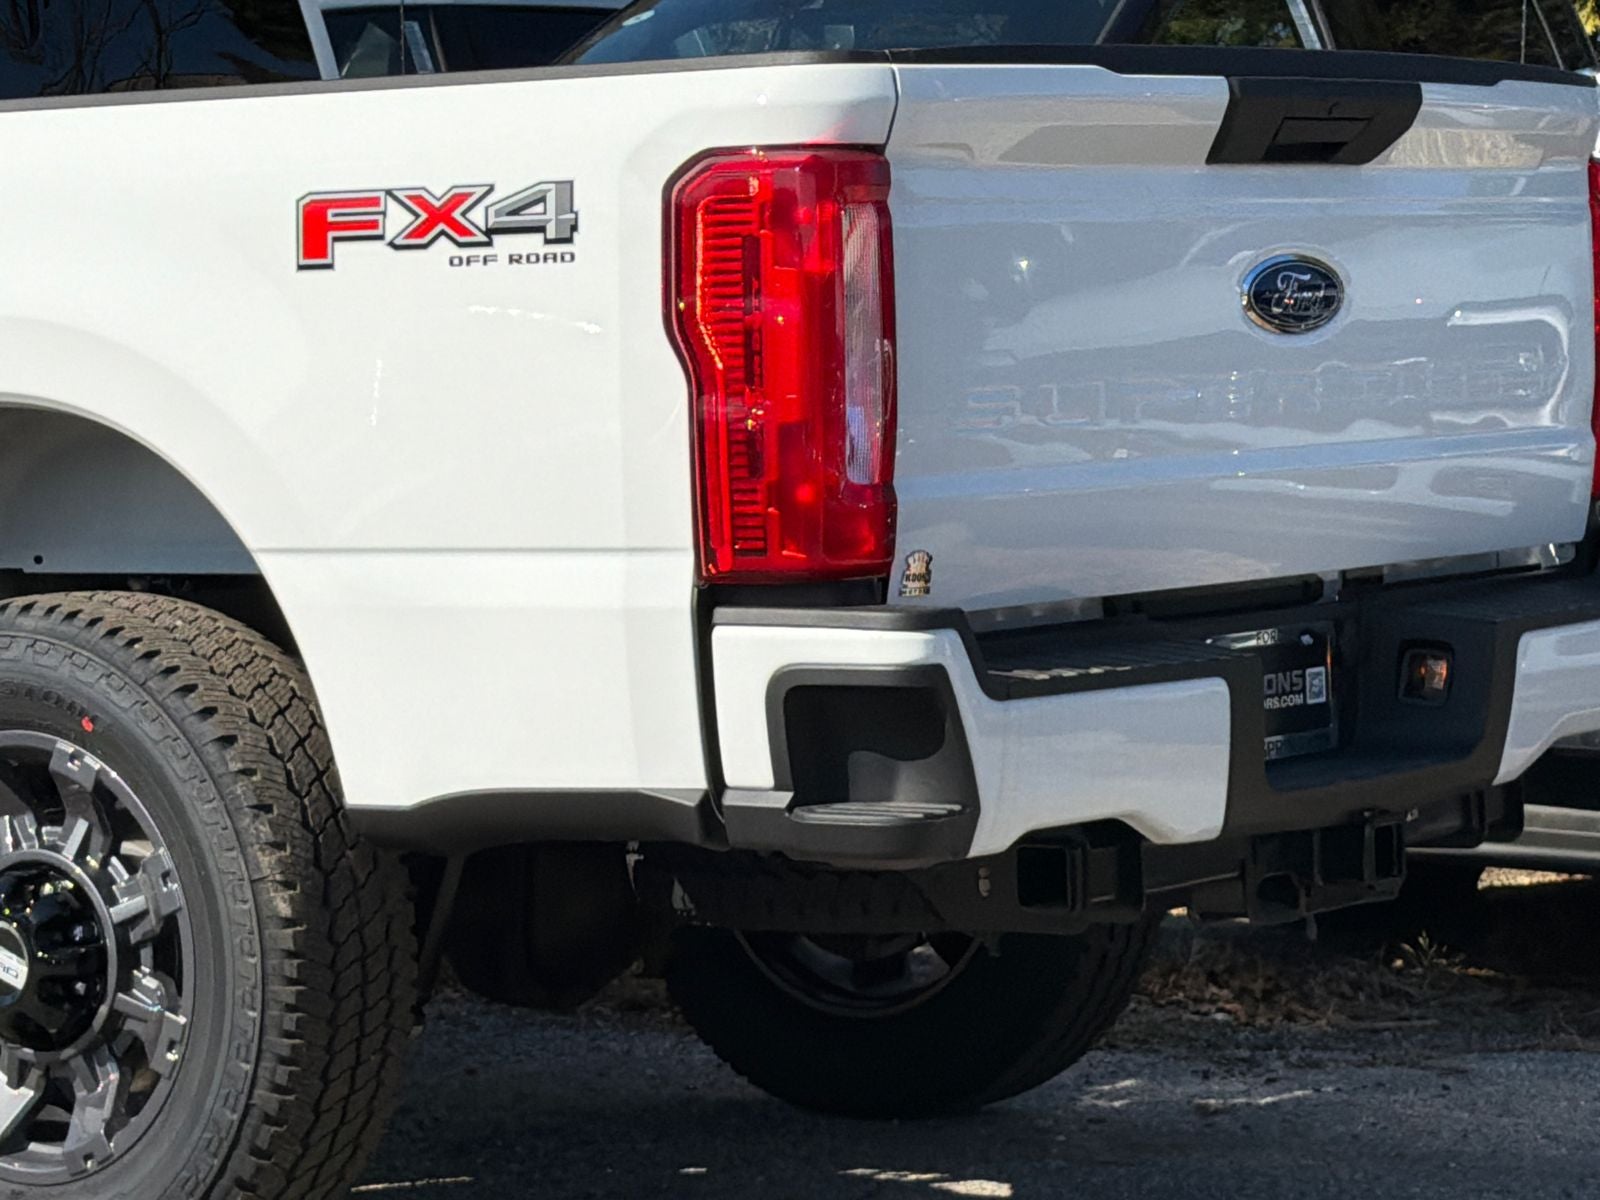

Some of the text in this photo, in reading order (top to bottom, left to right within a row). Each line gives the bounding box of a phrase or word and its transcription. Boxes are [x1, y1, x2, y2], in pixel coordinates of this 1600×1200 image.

[296, 180, 578, 271] FX4
[449, 251, 576, 267] OFF ROAD
[1271, 271, 1325, 315] Ford
[1264, 692, 1304, 710] RS.COM
